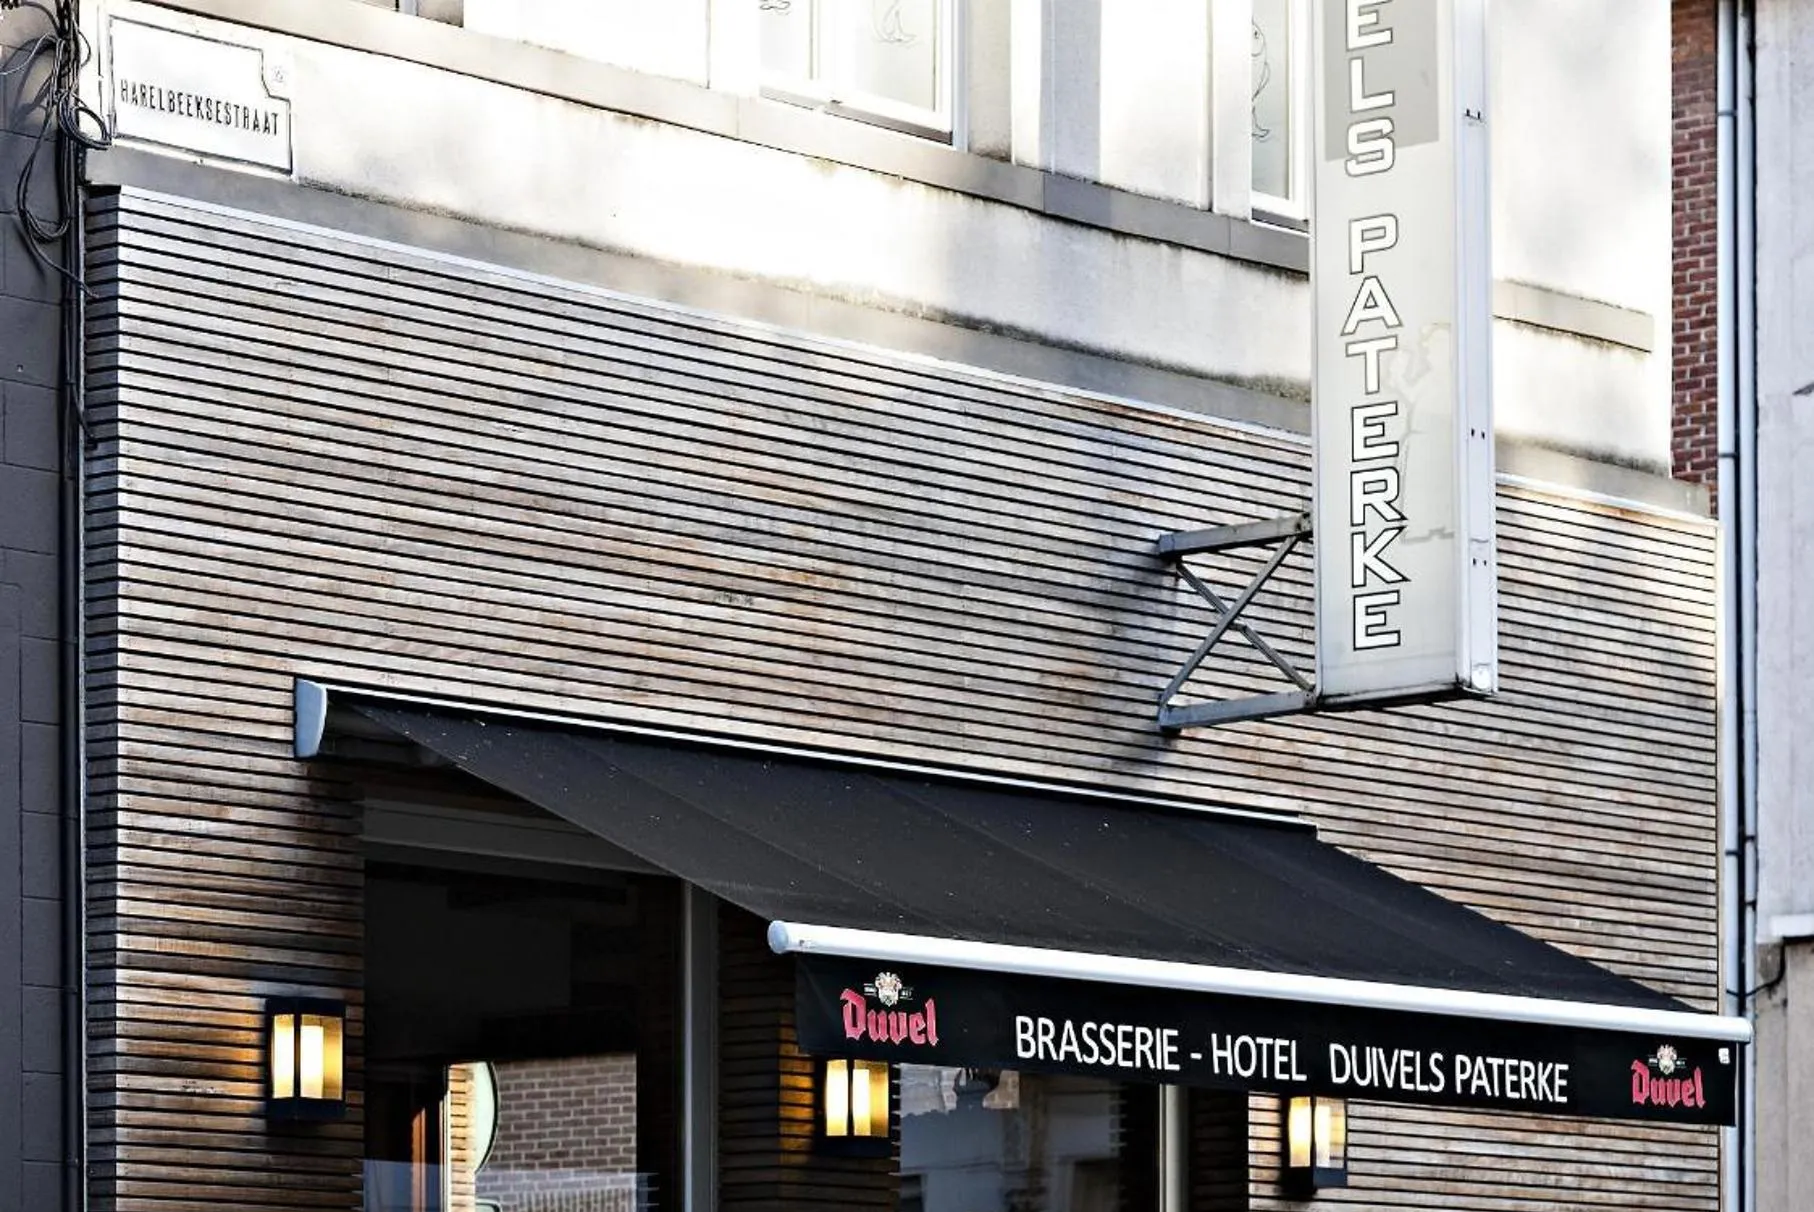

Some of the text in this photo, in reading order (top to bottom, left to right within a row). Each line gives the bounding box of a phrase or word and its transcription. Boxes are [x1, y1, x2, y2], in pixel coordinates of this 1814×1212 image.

[120, 79, 279, 136] HARELBEEKSESTRAAT
[1340, 213, 1412, 651] PATERKE
[840, 987, 940, 1046] Duvel
[1015, 1015, 1181, 1071] BRASSERIE
[1211, 1032, 1307, 1082] HOTEL
[1329, 1042, 1445, 1093] DUIVELS
[1455, 1055, 1569, 1103] PATERKE
[1631, 1060, 1706, 1109] Duvel
